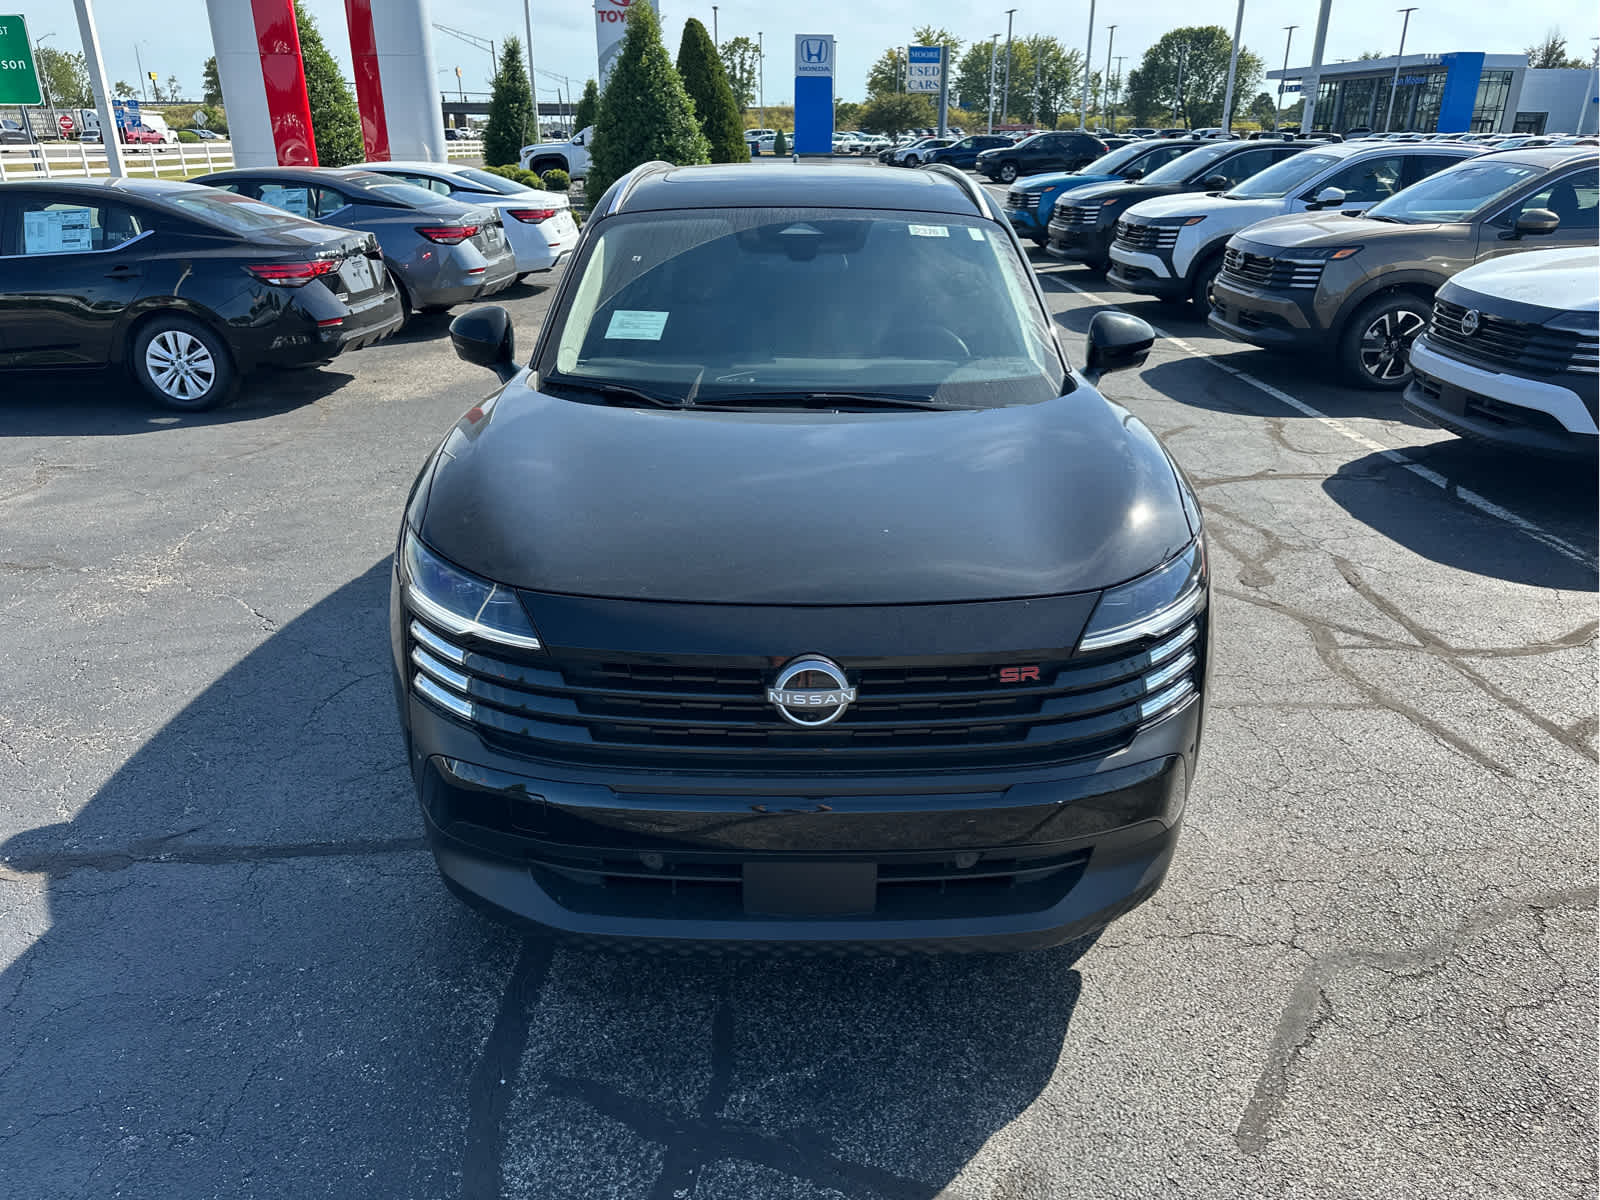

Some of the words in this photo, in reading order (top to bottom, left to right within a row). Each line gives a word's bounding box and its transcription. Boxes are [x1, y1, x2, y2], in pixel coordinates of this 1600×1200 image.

[597, 10, 625, 23] TOY
[909, 65, 940, 76] USED
[908, 80, 940, 90] CARS
[999, 666, 1040, 683] SR
[769, 690, 854, 705] NISSAN
